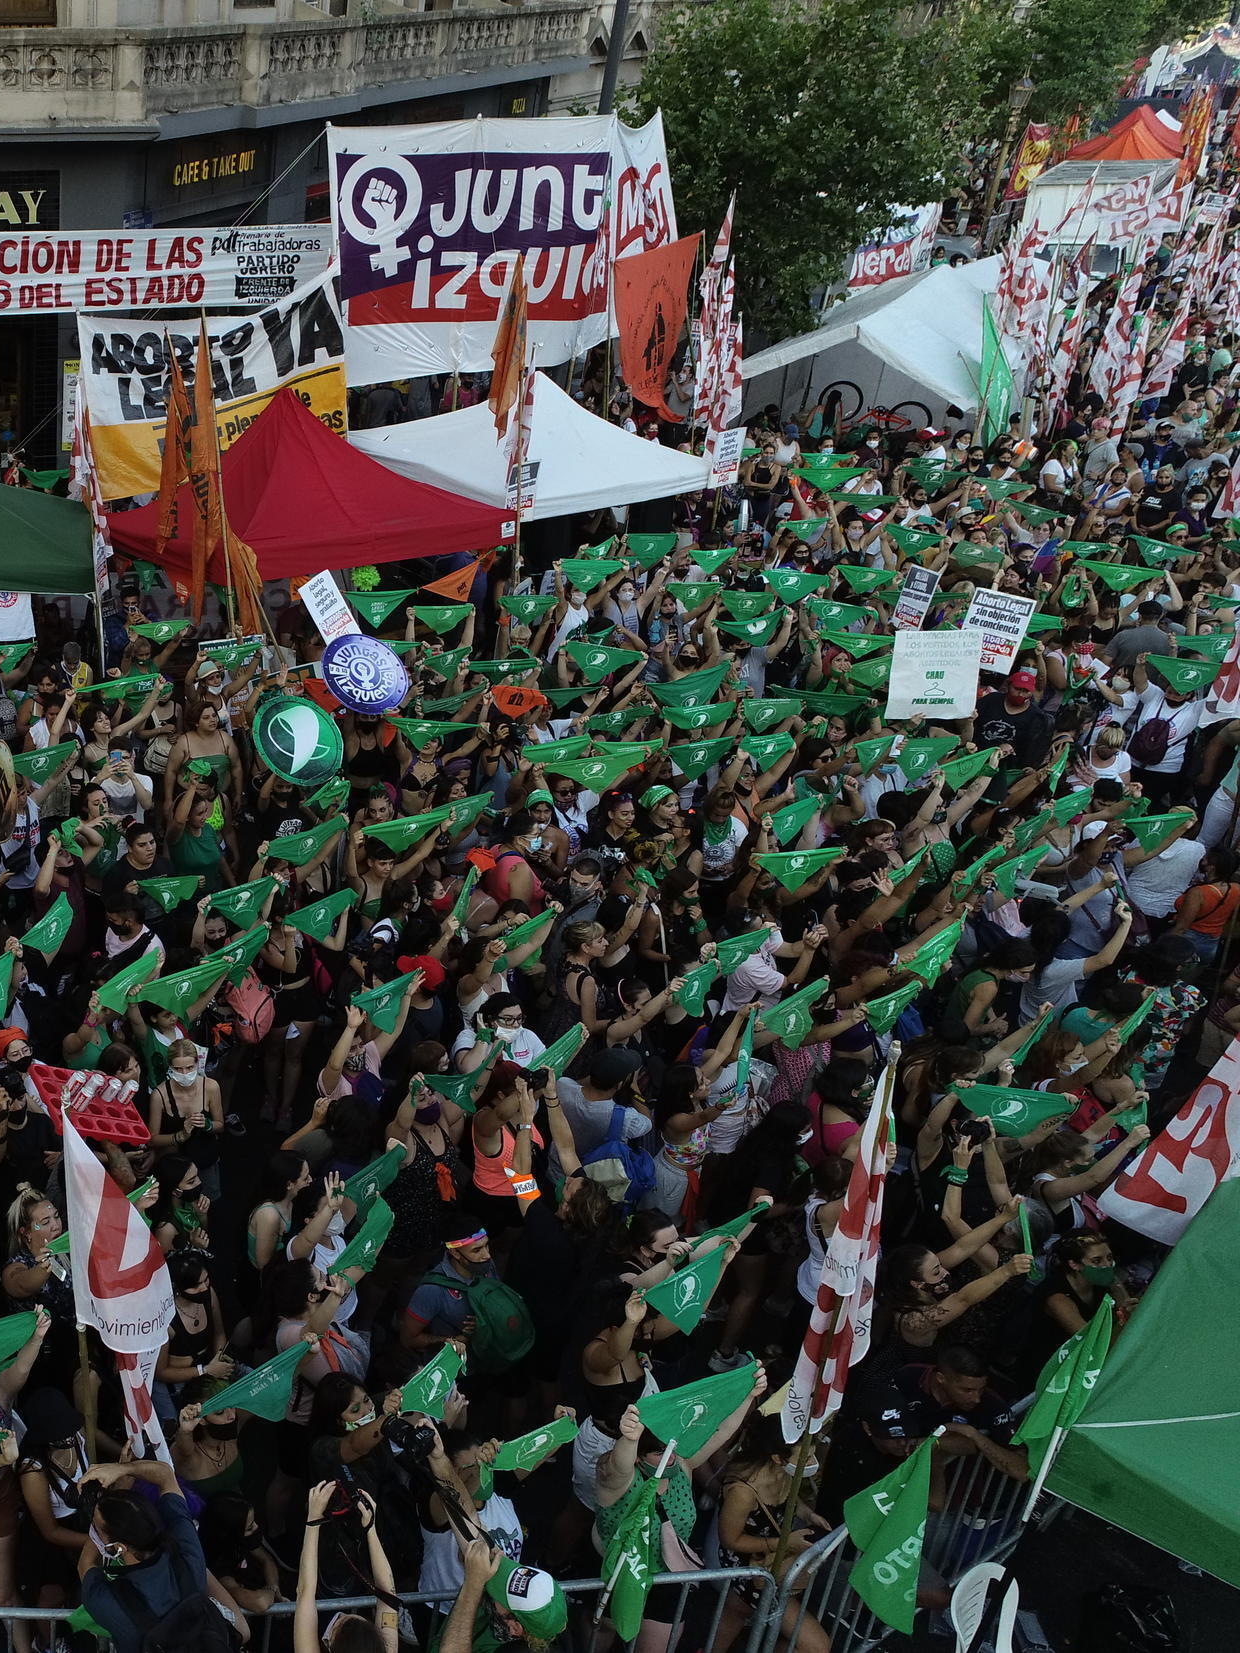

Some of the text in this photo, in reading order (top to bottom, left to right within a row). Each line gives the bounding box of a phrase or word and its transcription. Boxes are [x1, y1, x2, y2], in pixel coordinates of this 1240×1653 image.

[173, 150, 256, 186] CAFE & TAKE OUT
[275, 231, 285, 239] de
[237, 237, 321, 252] Trabajadoras
[96, 239, 134, 274] DE
[146, 236, 205, 272] LAS
[237, 254, 301, 267] PARTIDO
[242, 278, 278, 286] FRENTE
[19, 283, 73, 309] DEL
[84, 273, 206, 306] ESTADO
[239, 286, 292, 295] IZQUIERDA
[259, 283, 346, 379] YA
[975, 593, 1031, 616] Aborto Legal
[975, 606, 1022, 627] sin objeción
[969, 617, 1020, 636] de conciencia
[980, 653, 998, 666] ST
[925, 670, 945, 679] CHAU
[928, 697, 955, 705] SIEMPRE
